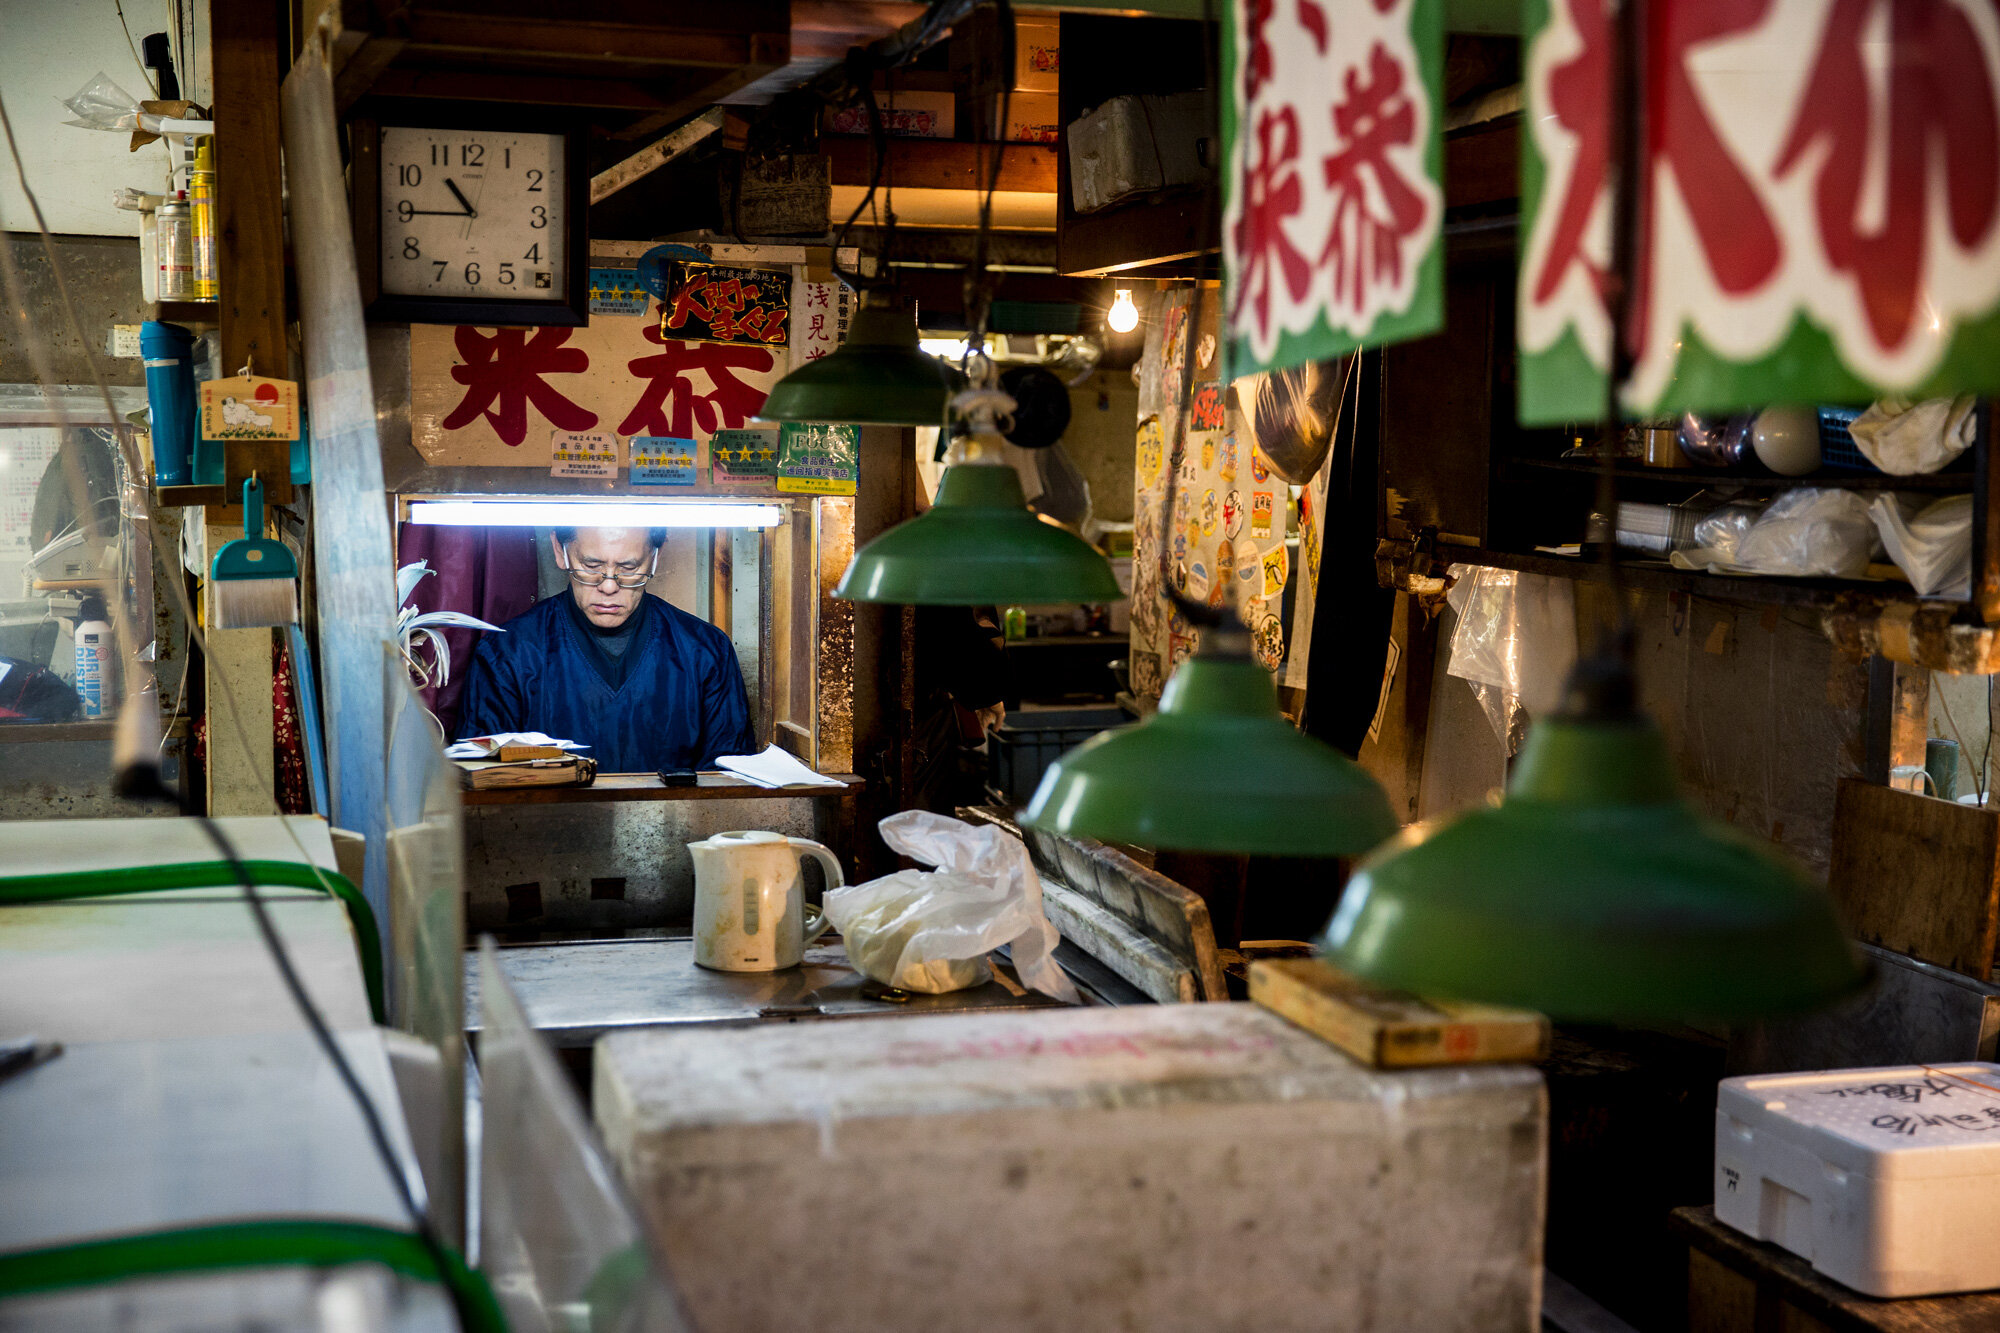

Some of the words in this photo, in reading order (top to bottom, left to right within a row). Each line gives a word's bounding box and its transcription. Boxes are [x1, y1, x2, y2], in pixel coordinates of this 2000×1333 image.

[431, 143, 448, 166] 11
[461, 143, 485, 167] 12
[504, 148, 510, 169] 1
[399, 164, 422, 187] 10
[526, 169, 544, 192] 2
[397, 200, 414, 223] 9
[530, 205, 548, 229] 3
[402, 236, 421, 260] 8
[523, 242, 543, 264] 4
[432, 260, 449, 282] 7
[464, 262, 481, 285] 6
[498, 262, 515, 285] 5
[710, 306, 789, 343] まぐろ
[560, 443, 610, 451] 食品衛生
[642, 447, 687, 455] 食品衛生
[786, 467, 848, 478] 巡回指導実施店
[801, 456, 836, 466] 食品衛生
[86, 648, 99, 672] AIR
